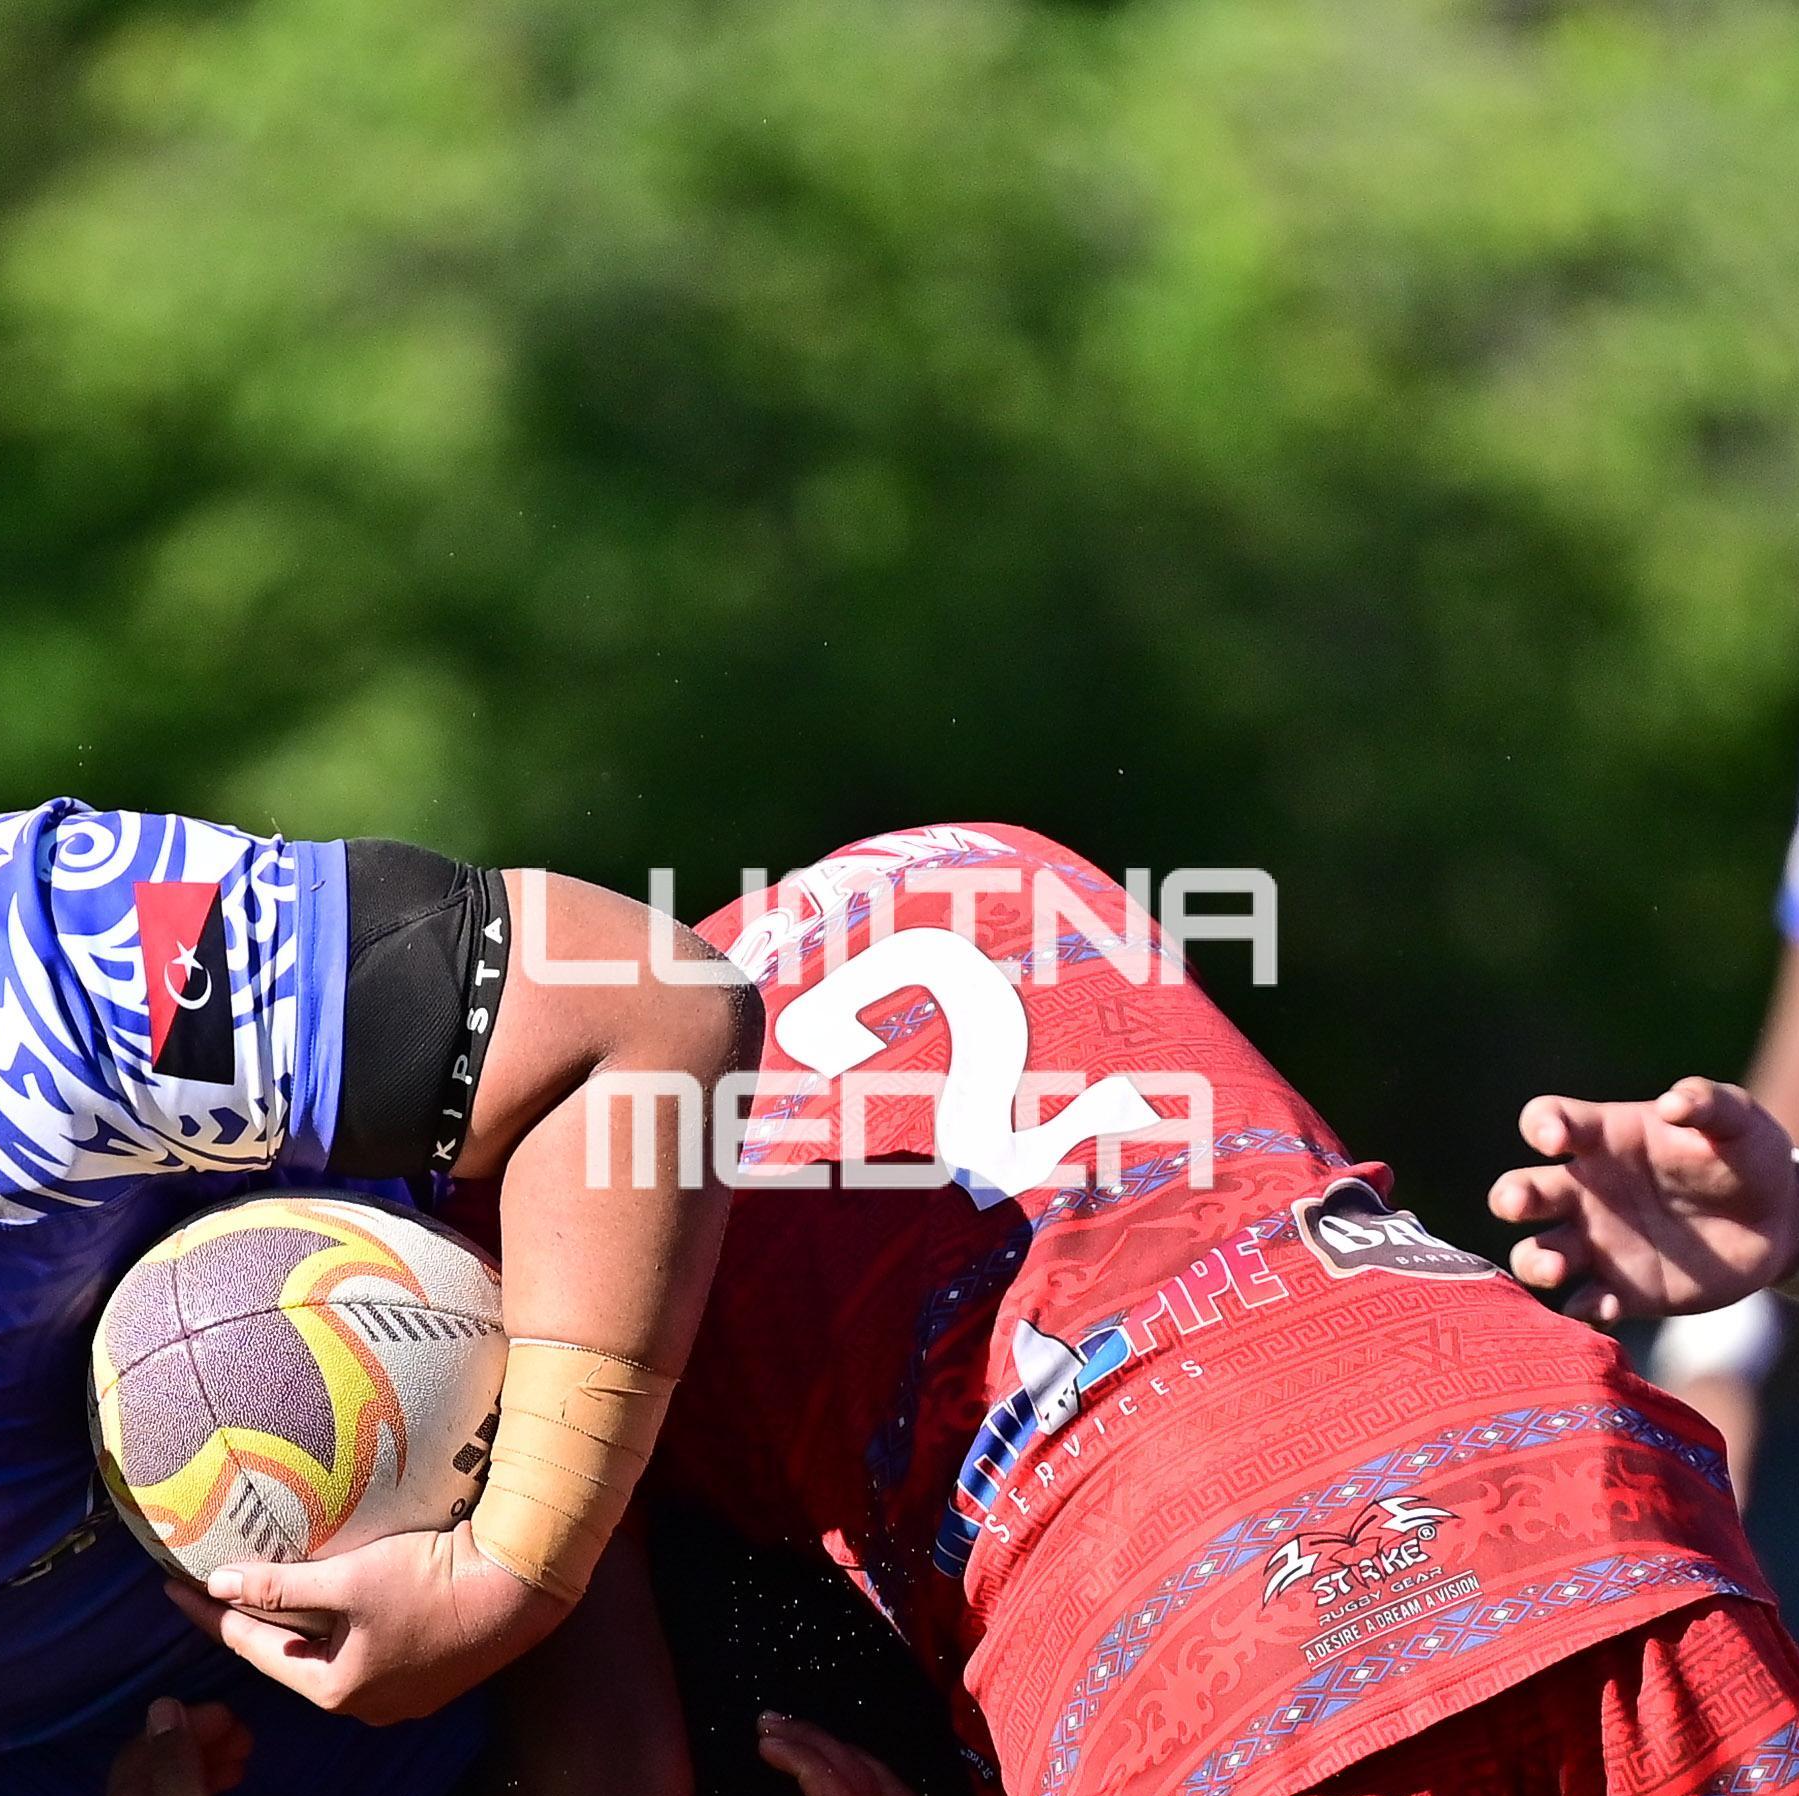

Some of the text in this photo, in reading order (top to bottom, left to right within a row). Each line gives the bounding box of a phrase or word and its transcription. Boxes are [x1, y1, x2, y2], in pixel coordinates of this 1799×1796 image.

[432, 917, 503, 1160] KIPSTA
[775, 926, 1162, 1210] 2
[984, 1360, 1204, 1544] SERVICES
[1305, 1576, 1481, 1664] A DESIRE A DREAM A VISION
[1312, 1538, 1431, 1607] STRIKE
[1319, 1566, 1444, 1626] RUGBY GEAR
